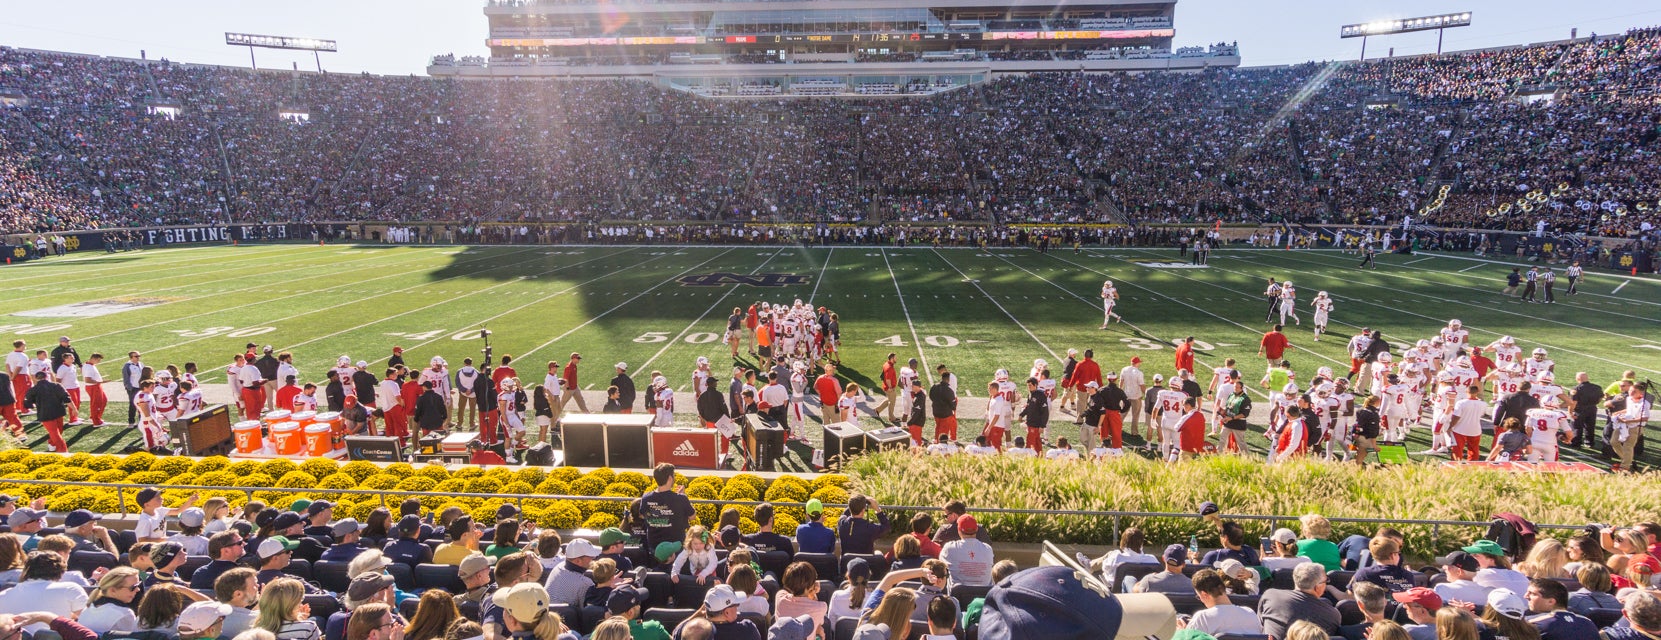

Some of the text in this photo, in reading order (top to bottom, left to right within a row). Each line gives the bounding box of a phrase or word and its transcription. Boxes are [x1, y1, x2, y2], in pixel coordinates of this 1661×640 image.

[148, 226, 227, 244] FGHTING
[631, 331, 718, 343] 50
[874, 334, 960, 347] 40
[1498, 353, 1513, 362] 38
[342, 376, 350, 385] 2
[1454, 376, 1472, 387] 44
[1501, 382, 1517, 392] 48
[1396, 393, 1402, 404] 6
[1163, 400, 1180, 412] 84
